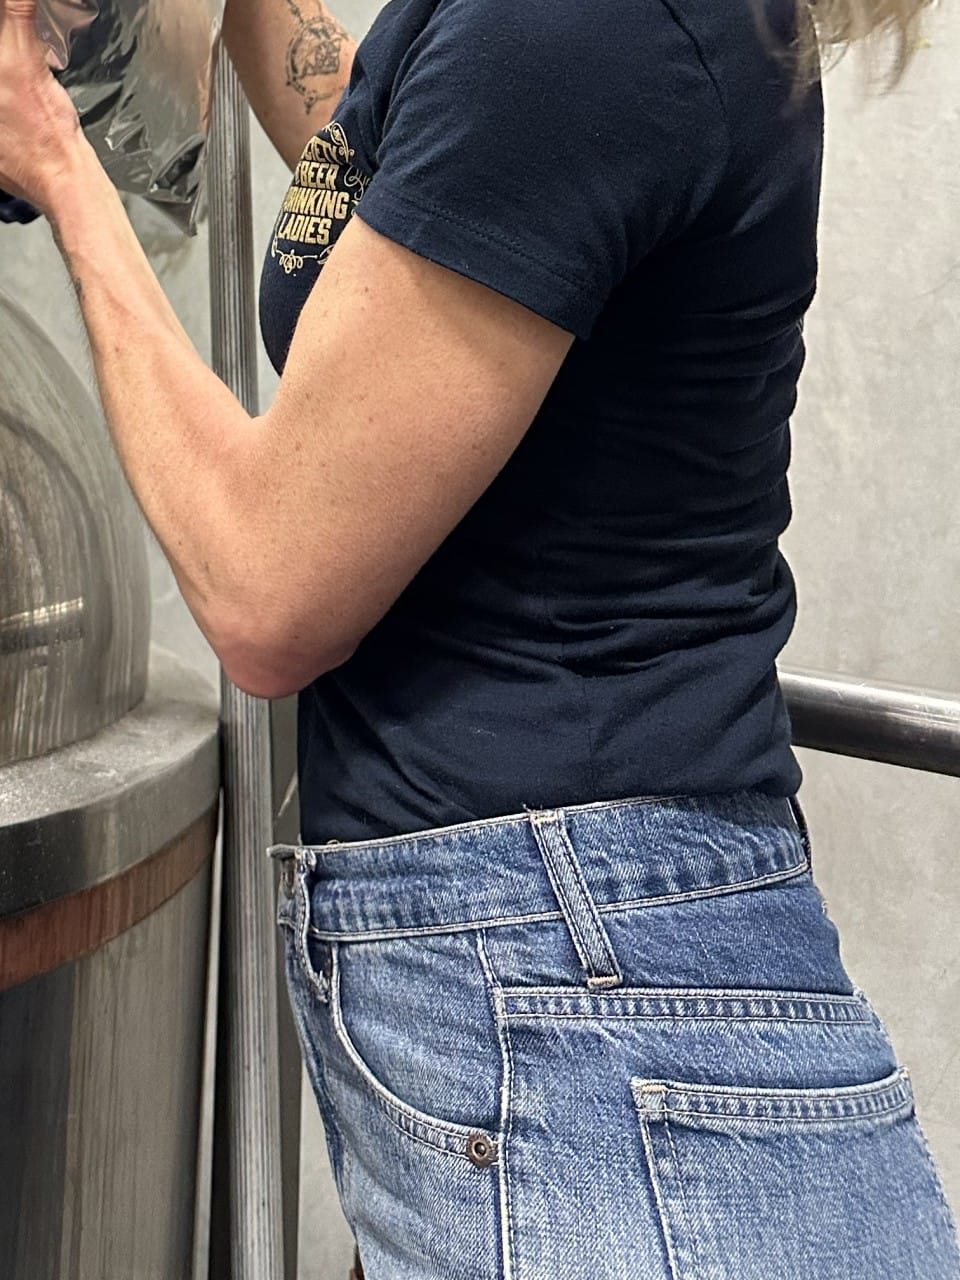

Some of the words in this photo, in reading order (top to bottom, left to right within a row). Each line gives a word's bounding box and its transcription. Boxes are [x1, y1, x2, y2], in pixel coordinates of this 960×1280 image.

[301, 136, 344, 166] CIETY
[300, 160, 339, 190] BEER
[283, 186, 350, 220] RINKING
[278, 212, 332, 245] LADIES
